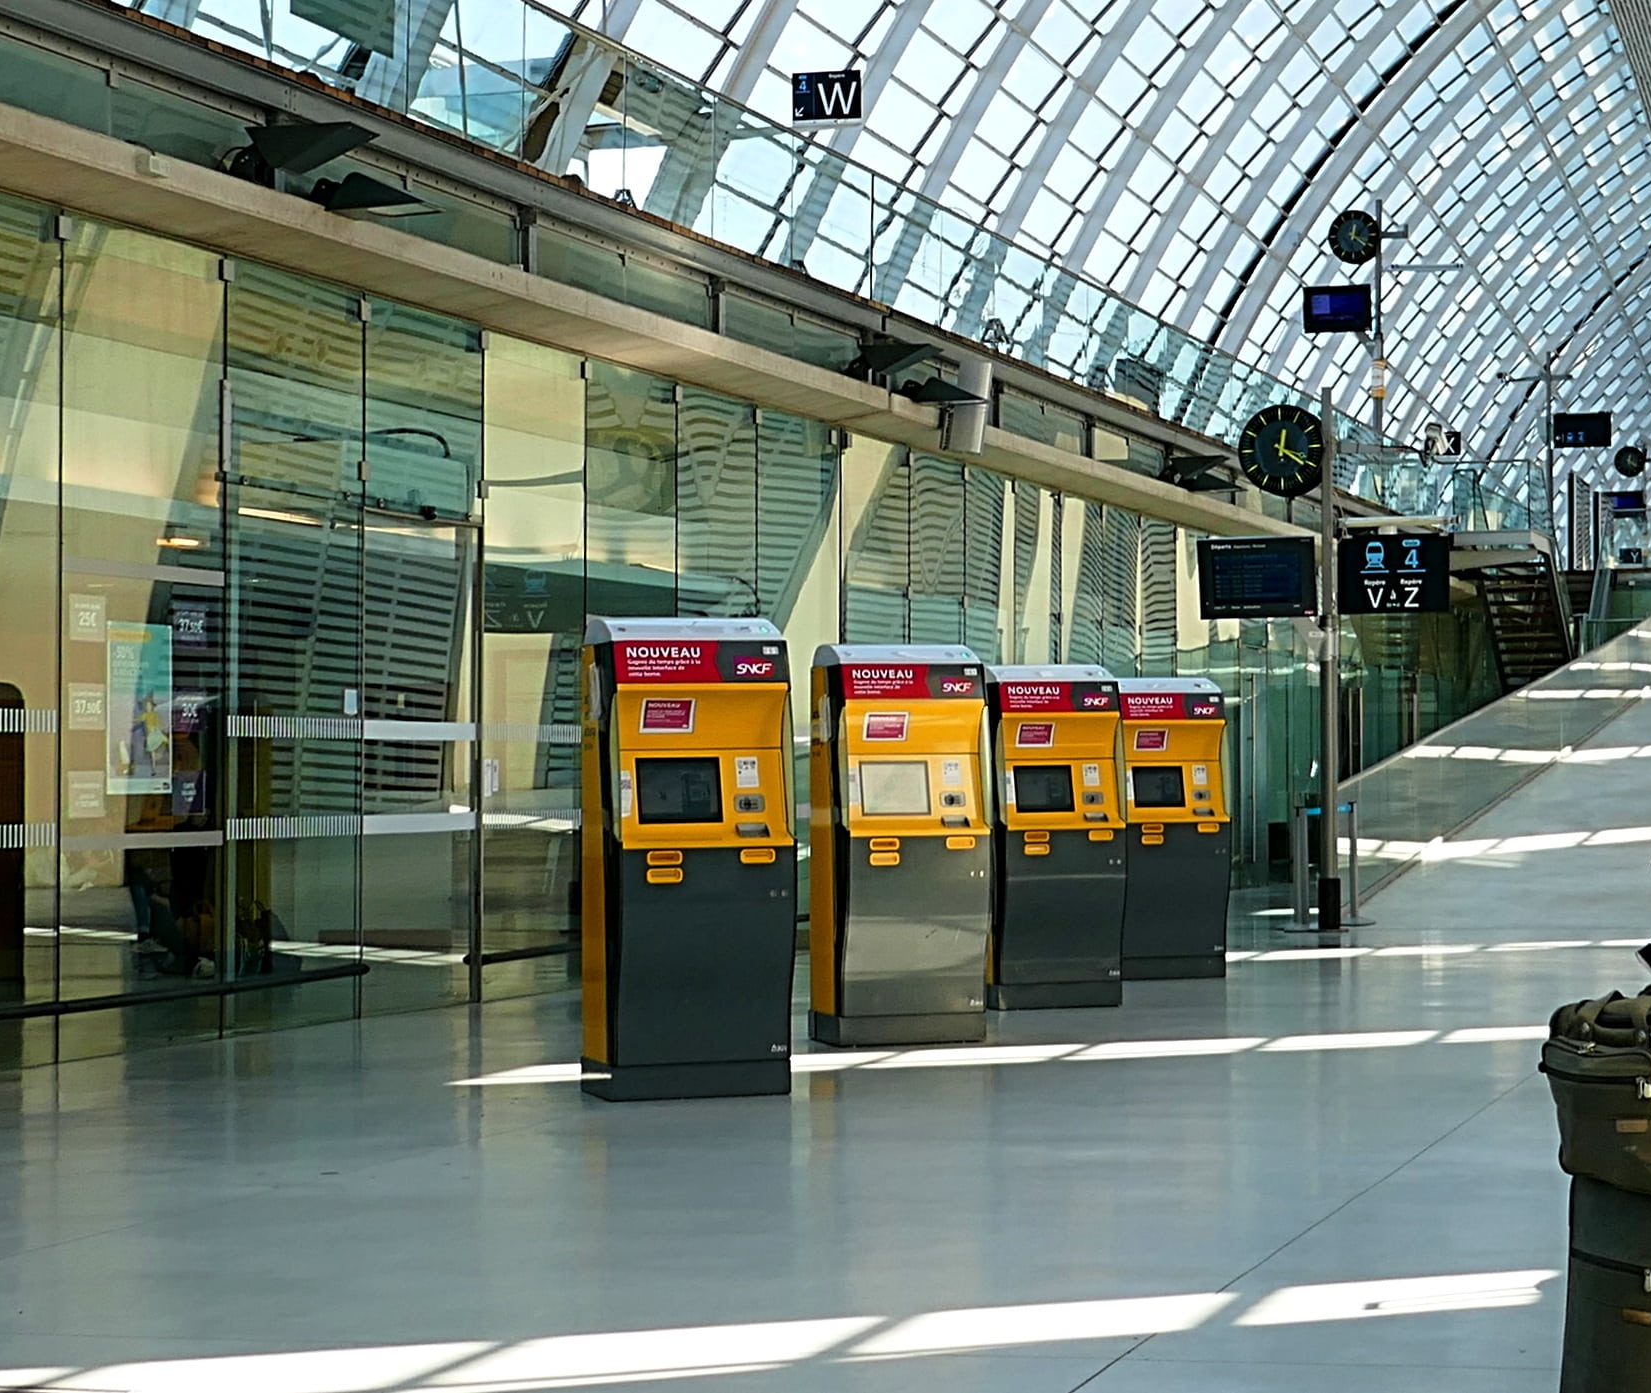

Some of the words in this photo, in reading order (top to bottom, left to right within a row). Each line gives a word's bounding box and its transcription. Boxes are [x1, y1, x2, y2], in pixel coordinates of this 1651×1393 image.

[799, 80, 807, 92] 4
[817, 81, 857, 116] W
[1404, 549, 1419, 568] 4
[1367, 587, 1384, 609] V
[1404, 587, 1420, 608] Z
[626, 646, 700, 658] NOUVEAU
[736, 663, 773, 675] SNCF
[852, 669, 913, 679] NOUVEAU
[942, 682, 972, 693] SNCF
[1007, 686, 1060, 695] NOUVEAU
[1083, 697, 1109, 706] SNCF
[1127, 697, 1173, 705] NOUVEAU
[1193, 707, 1215, 715] SNCF
